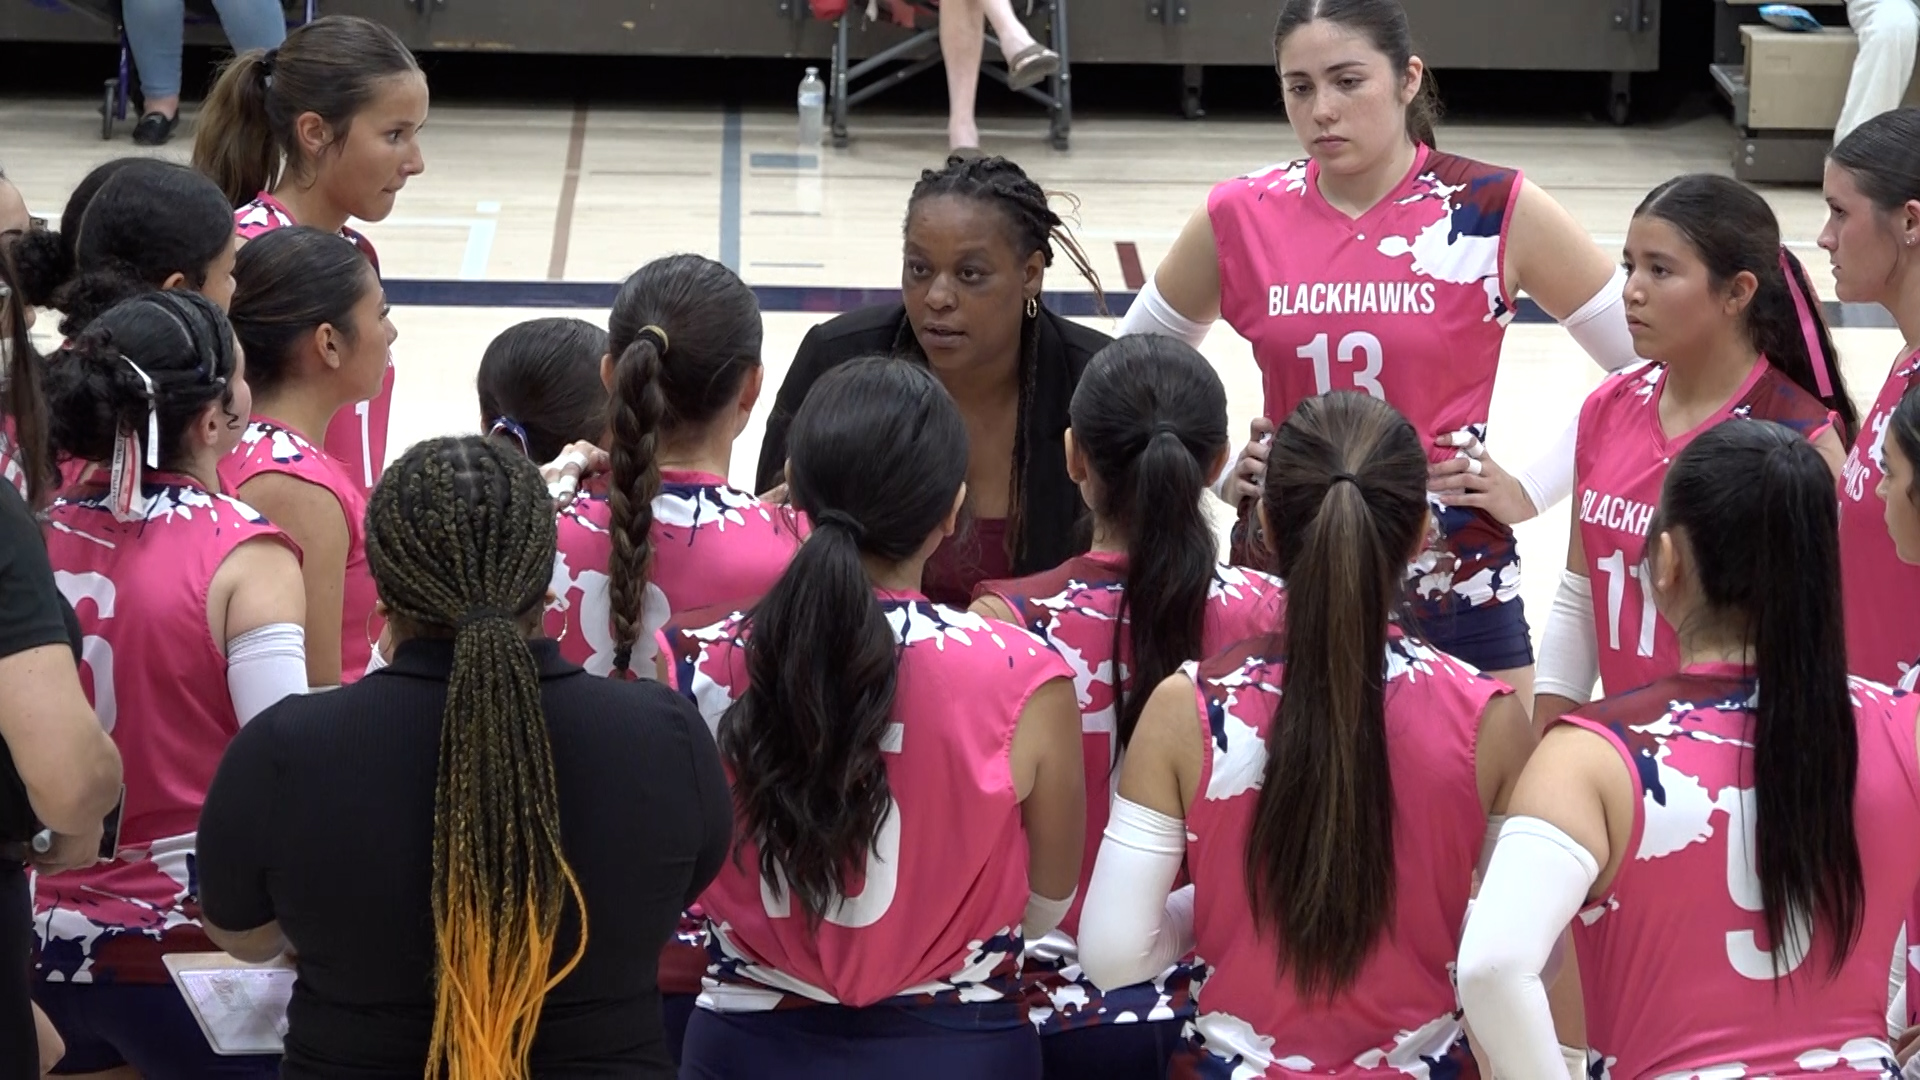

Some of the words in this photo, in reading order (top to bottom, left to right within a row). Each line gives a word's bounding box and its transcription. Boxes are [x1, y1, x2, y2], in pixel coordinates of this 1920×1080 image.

[1268, 282, 1436, 316] BLACKHAWKS
[1296, 331, 1386, 401] 13
[1579, 488, 1656, 537] BLACKH
[579, 569, 672, 680] 8
[1597, 548, 1658, 658] 11
